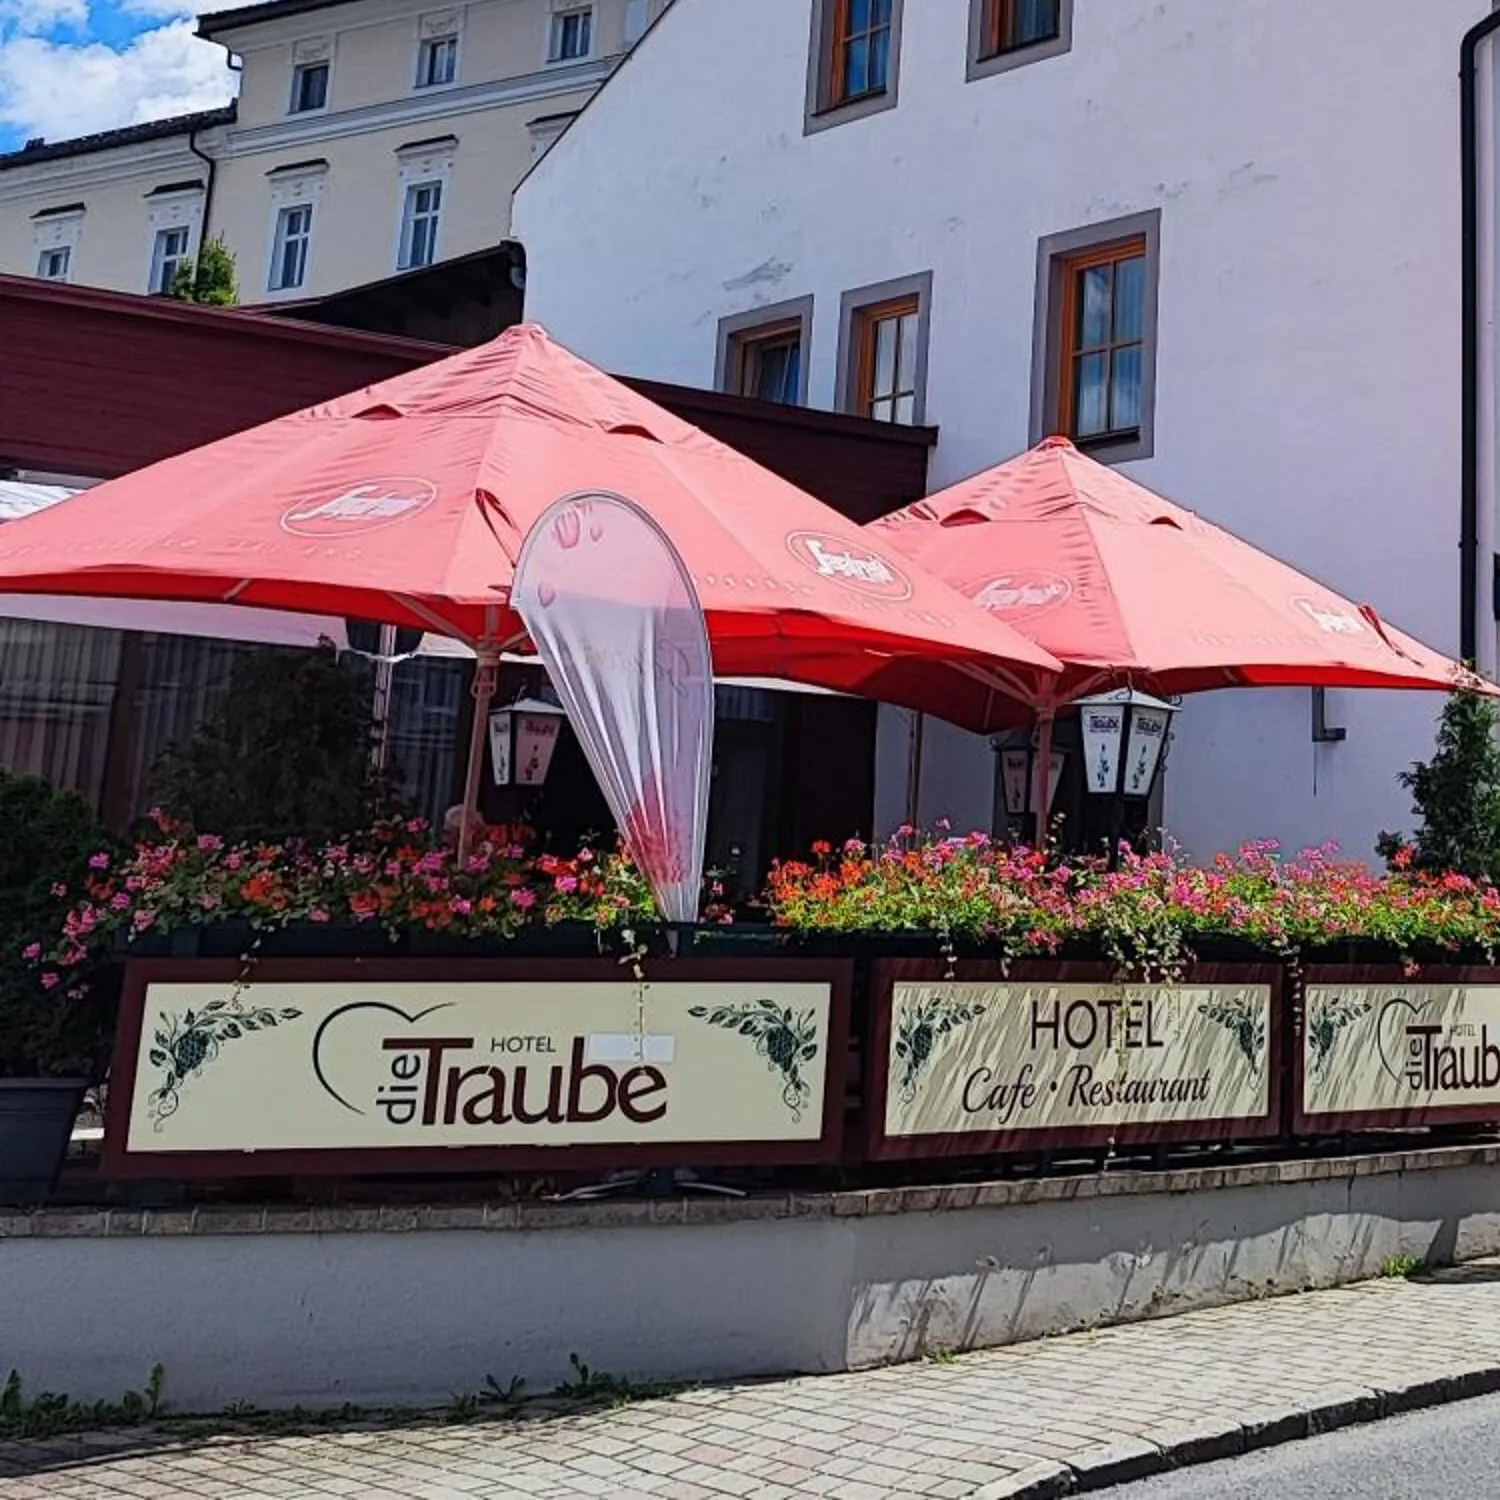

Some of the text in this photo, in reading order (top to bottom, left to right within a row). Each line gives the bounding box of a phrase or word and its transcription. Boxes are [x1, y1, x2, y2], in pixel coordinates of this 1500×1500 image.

[490, 1036, 557, 1053] HOTEL
[1030, 999, 1164, 1050] HOTEL
[375, 1035, 668, 1126] die Traube
[1405, 1037, 1423, 1091] die
[962, 1063, 1212, 1125] Cafe Restaurant
